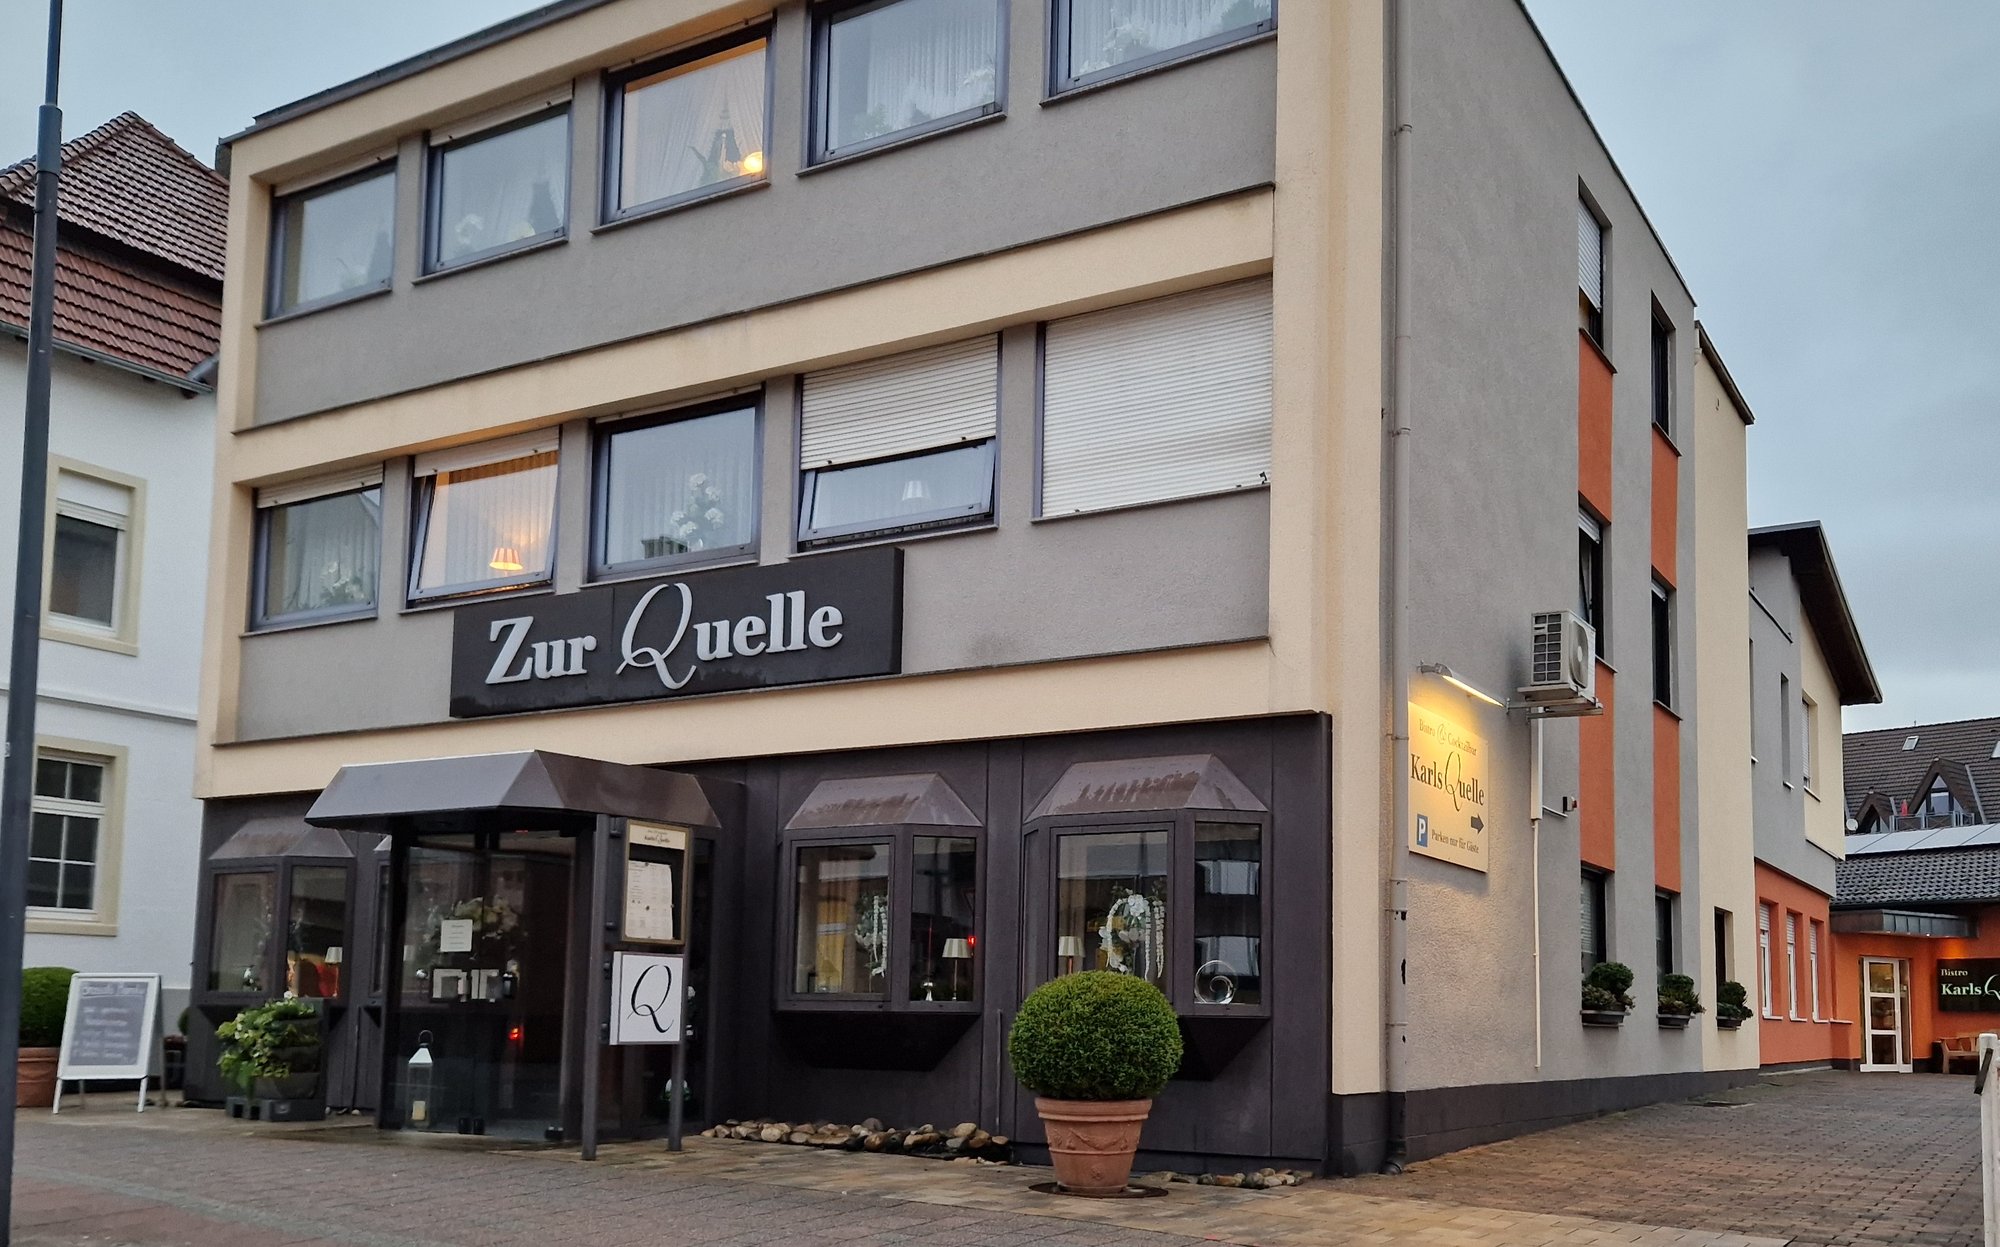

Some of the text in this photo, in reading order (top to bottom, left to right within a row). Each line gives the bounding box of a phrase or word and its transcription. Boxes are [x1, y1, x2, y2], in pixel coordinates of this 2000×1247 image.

[485, 582, 844, 690] Zur Quelle
[1418, 818, 1426, 842] P
[1431, 829, 1449, 844] Parken
[1449, 837, 1458, 847] nur
[1941, 968, 1968, 977] Bistro
[626, 964, 675, 1034] Q
